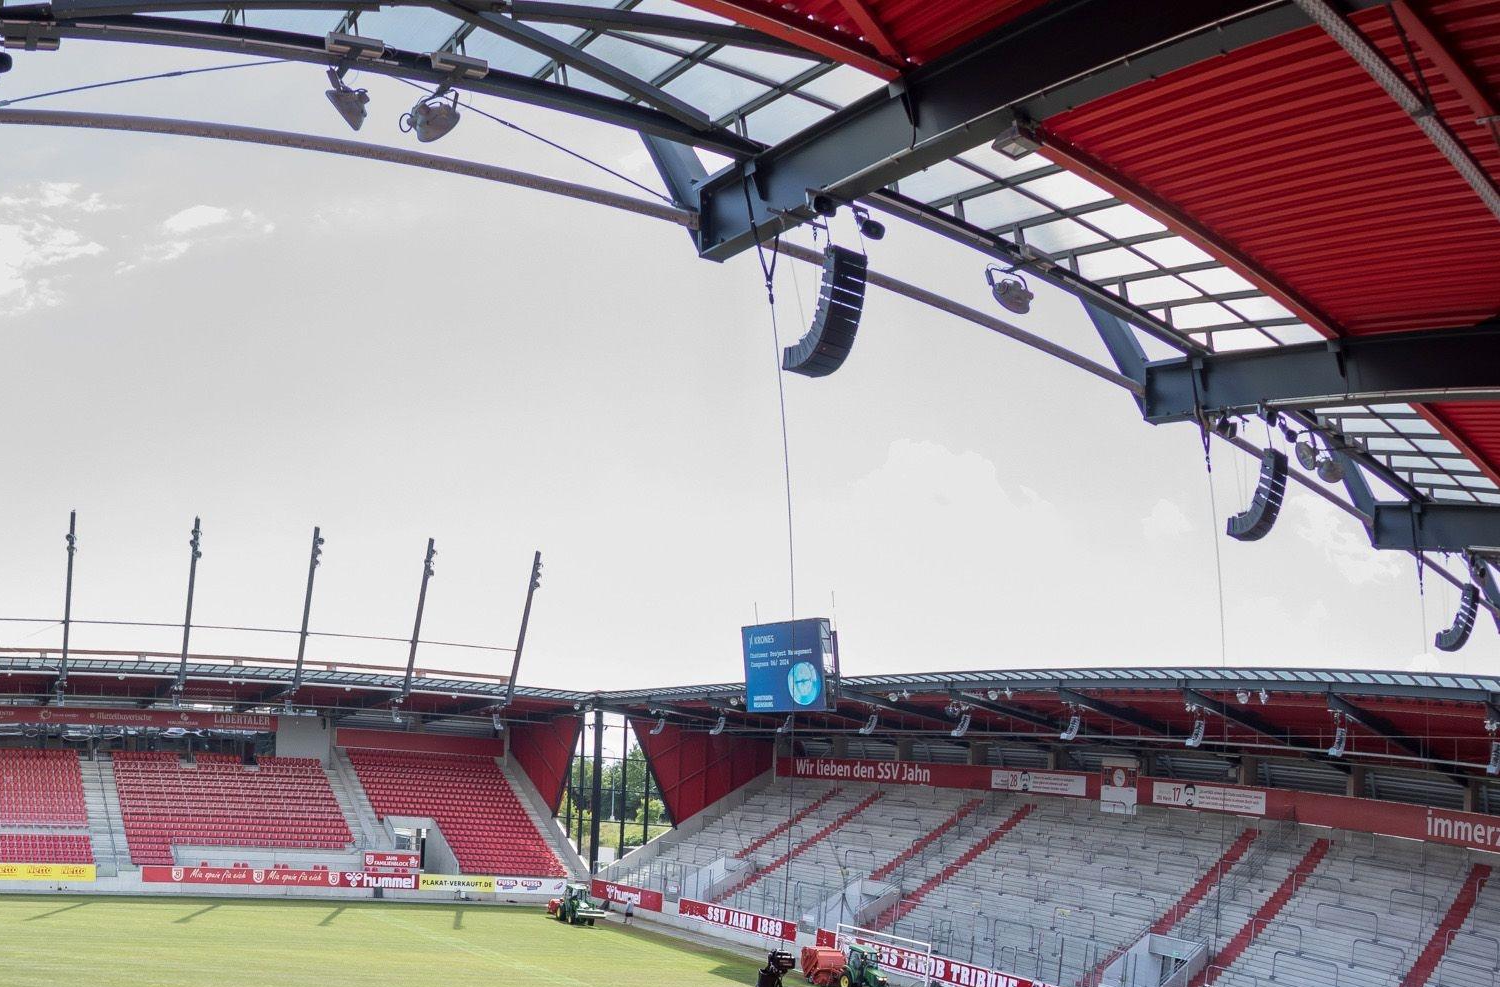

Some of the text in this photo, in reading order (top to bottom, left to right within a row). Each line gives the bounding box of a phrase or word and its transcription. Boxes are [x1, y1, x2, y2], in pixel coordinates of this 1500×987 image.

[796, 759, 930, 782] Wir lieben den SSV Jahn
[1172, 787, 1181, 802] 17
[373, 860, 409, 868] FAMILIENBLOCK
[363, 875, 415, 888] hummel
[422, 879, 492, 888] PLAKAT-VERKAUFT.DE
[614, 886, 641, 905] hummel
[707, 906, 782, 938] SSV JAHN 1889
[902, 951, 945, 978] JAKOB
